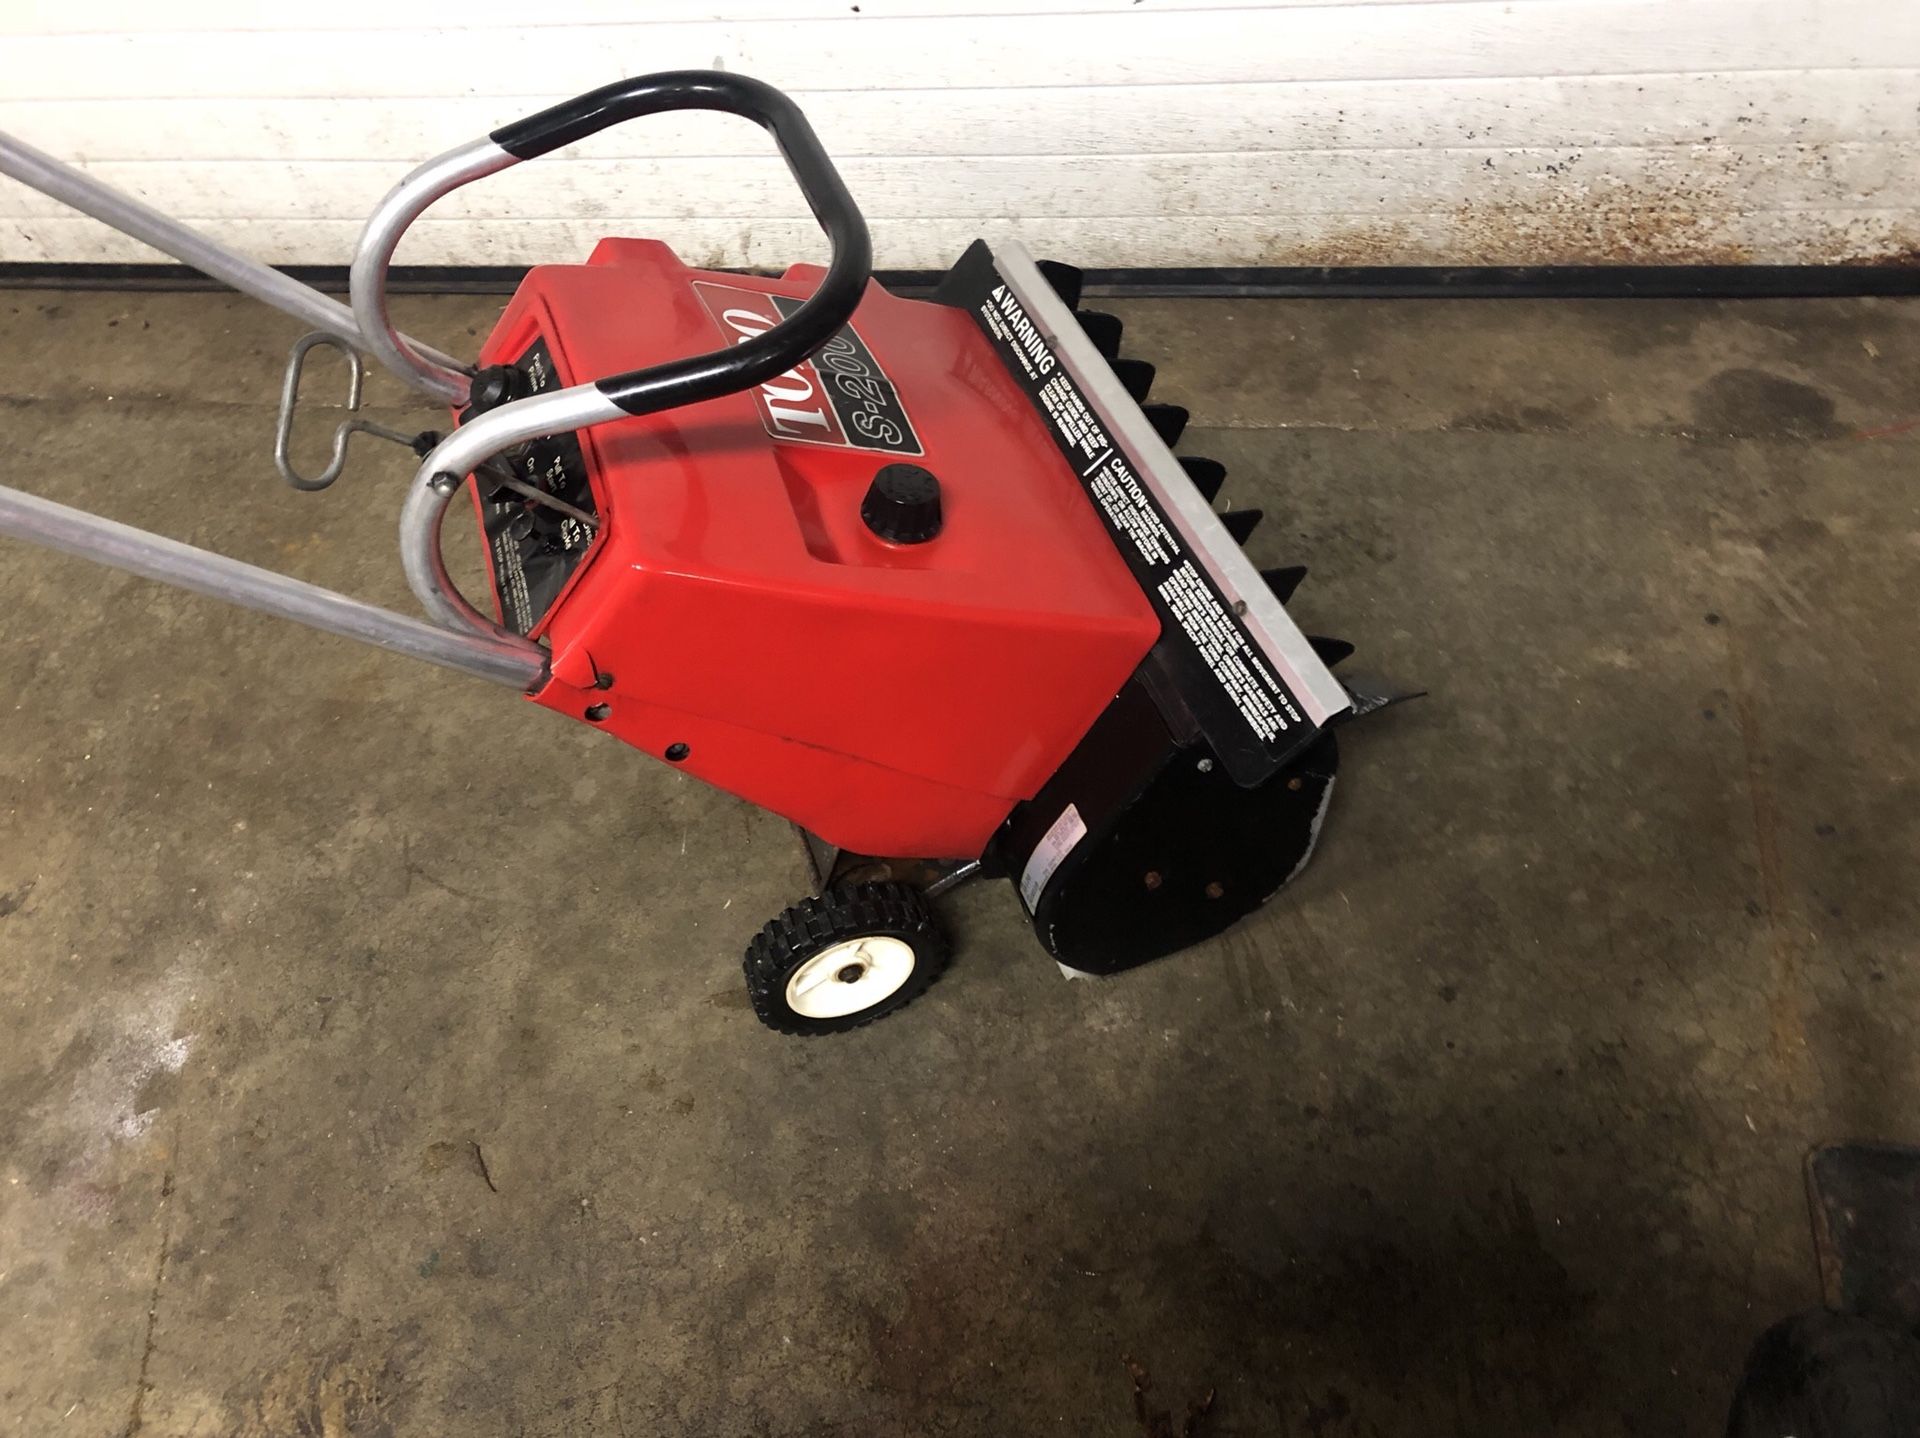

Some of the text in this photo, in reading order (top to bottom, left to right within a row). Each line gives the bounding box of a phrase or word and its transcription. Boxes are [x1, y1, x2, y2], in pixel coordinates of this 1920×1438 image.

[992, 309, 1001, 322] NOT
[998, 320, 1013, 341] DIRECT
[1010, 339, 1032, 372] DISCHARGE
[1029, 371, 1038, 380] AT
[1000, 292, 1054, 374] WARNING
[1038, 389, 1055, 412] ENGINE
[1051, 410, 1059, 419] IS
[1044, 383, 1095, 459] CLEAR OF IMPELLER WHILE
[1050, 377, 1099, 448] CHARGE GUIDE AND KEEP
[1058, 375, 1071, 390] KEEP
[1068, 390, 1085, 413] HANDS
[1082, 411, 1094, 425] OUT
[1090, 424, 1100, 434] OF
[1110, 458, 1147, 507] CAUTION
[572, 525, 581, 543] To
[1114, 485, 1130, 504] DIRECT
[1127, 503, 1151, 536] DISCHARGE
[1148, 534, 1170, 564] TOWARDS
[1117, 512, 1130, 528] NEAR
[1128, 527, 1137, 540] THE
[1122, 509, 1138, 528] ALLOW
[1135, 528, 1154, 552] ANYONE
[1157, 523, 1180, 554] POTENTIAL
[1162, 581, 1187, 613] AVAILABLE
[1184, 612, 1199, 631] FROM
[1197, 630, 1208, 644] THE
[1206, 642, 1220, 661] TORO
[1179, 566, 1197, 589] BEFORE
[1194, 588, 1219, 621] SERVICING
[1168, 576, 1193, 610] OPERATING
[1242, 682, 1268, 717] MANUALS
[1265, 716, 1278, 731] ARE
[1181, 620, 1201, 645] SPECIFY
[1198, 645, 1215, 668] MODEL
[1213, 668, 1226, 683] AND
[1223, 682, 1241, 706] SERIAL
[1184, 561, 1301, 721] STOP ENGINE AND WAIT FOR ALL MOVEMENT TO STOP
[1204, 615, 1225, 643] MANUAL
[1223, 642, 1235, 656] FOR
[1232, 655, 1258, 689] COMPLETE
[1255, 688, 1276, 713] SAFETY
[1273, 714, 1287, 730] AND
